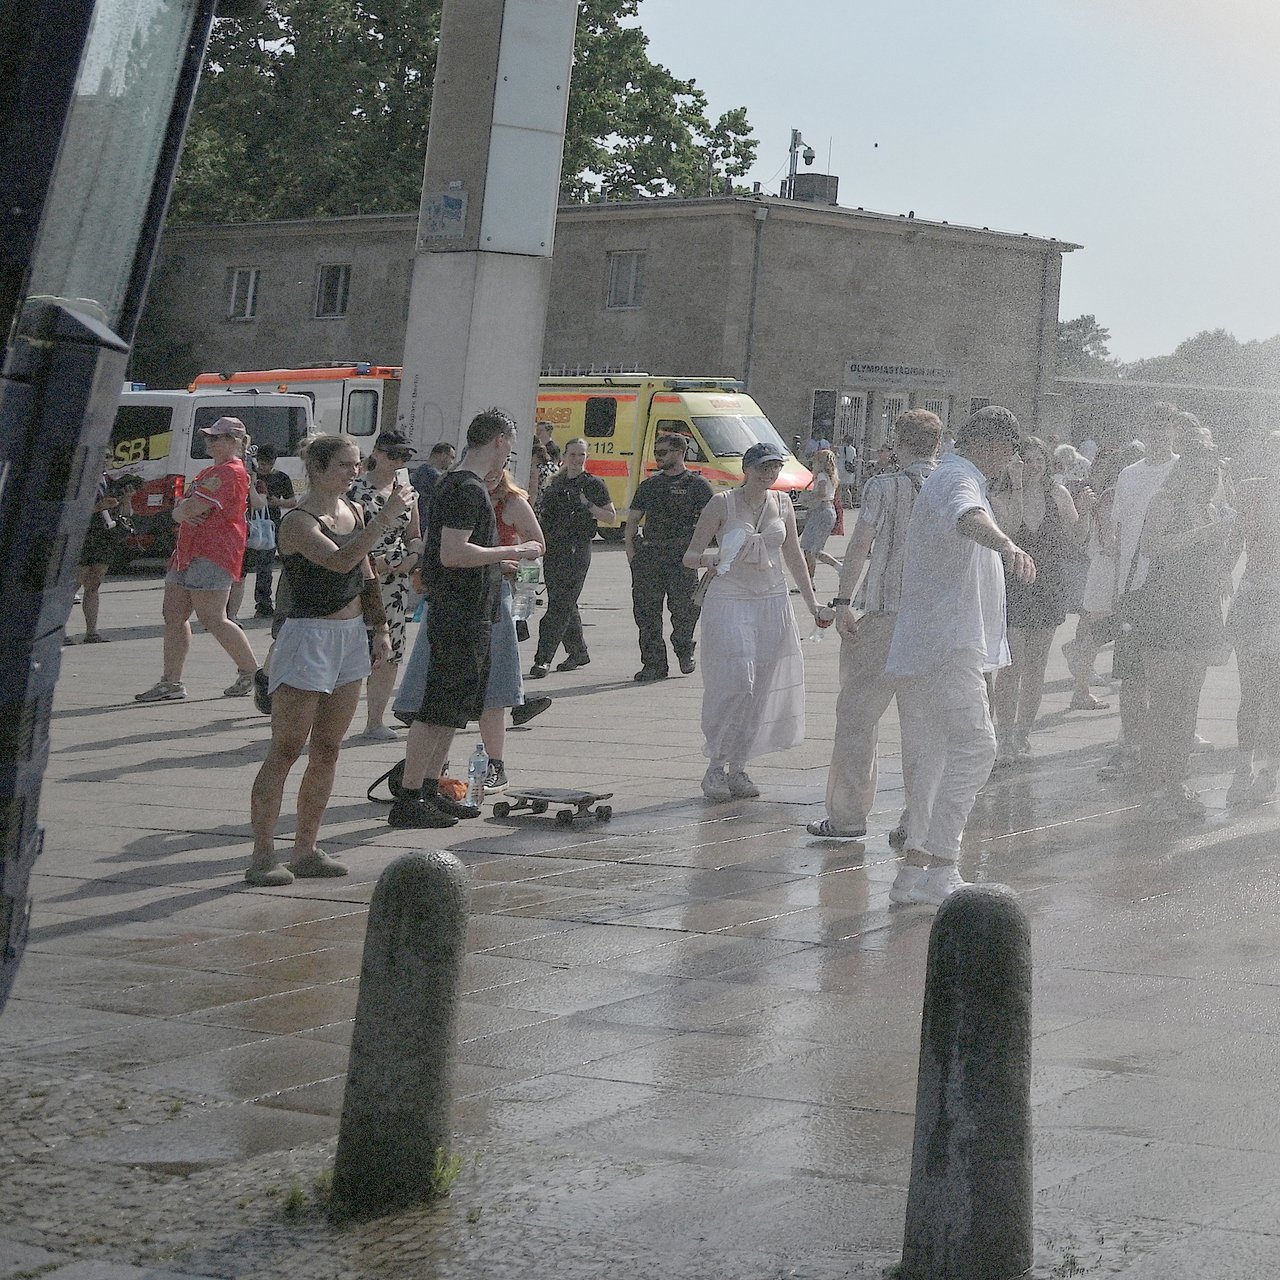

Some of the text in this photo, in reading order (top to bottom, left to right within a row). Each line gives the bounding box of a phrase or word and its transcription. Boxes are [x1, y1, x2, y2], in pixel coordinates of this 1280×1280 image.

[850, 363, 925, 376] OLYMPIASTADION
[112, 437, 147, 469] SB
[594, 442, 614, 454] 112
